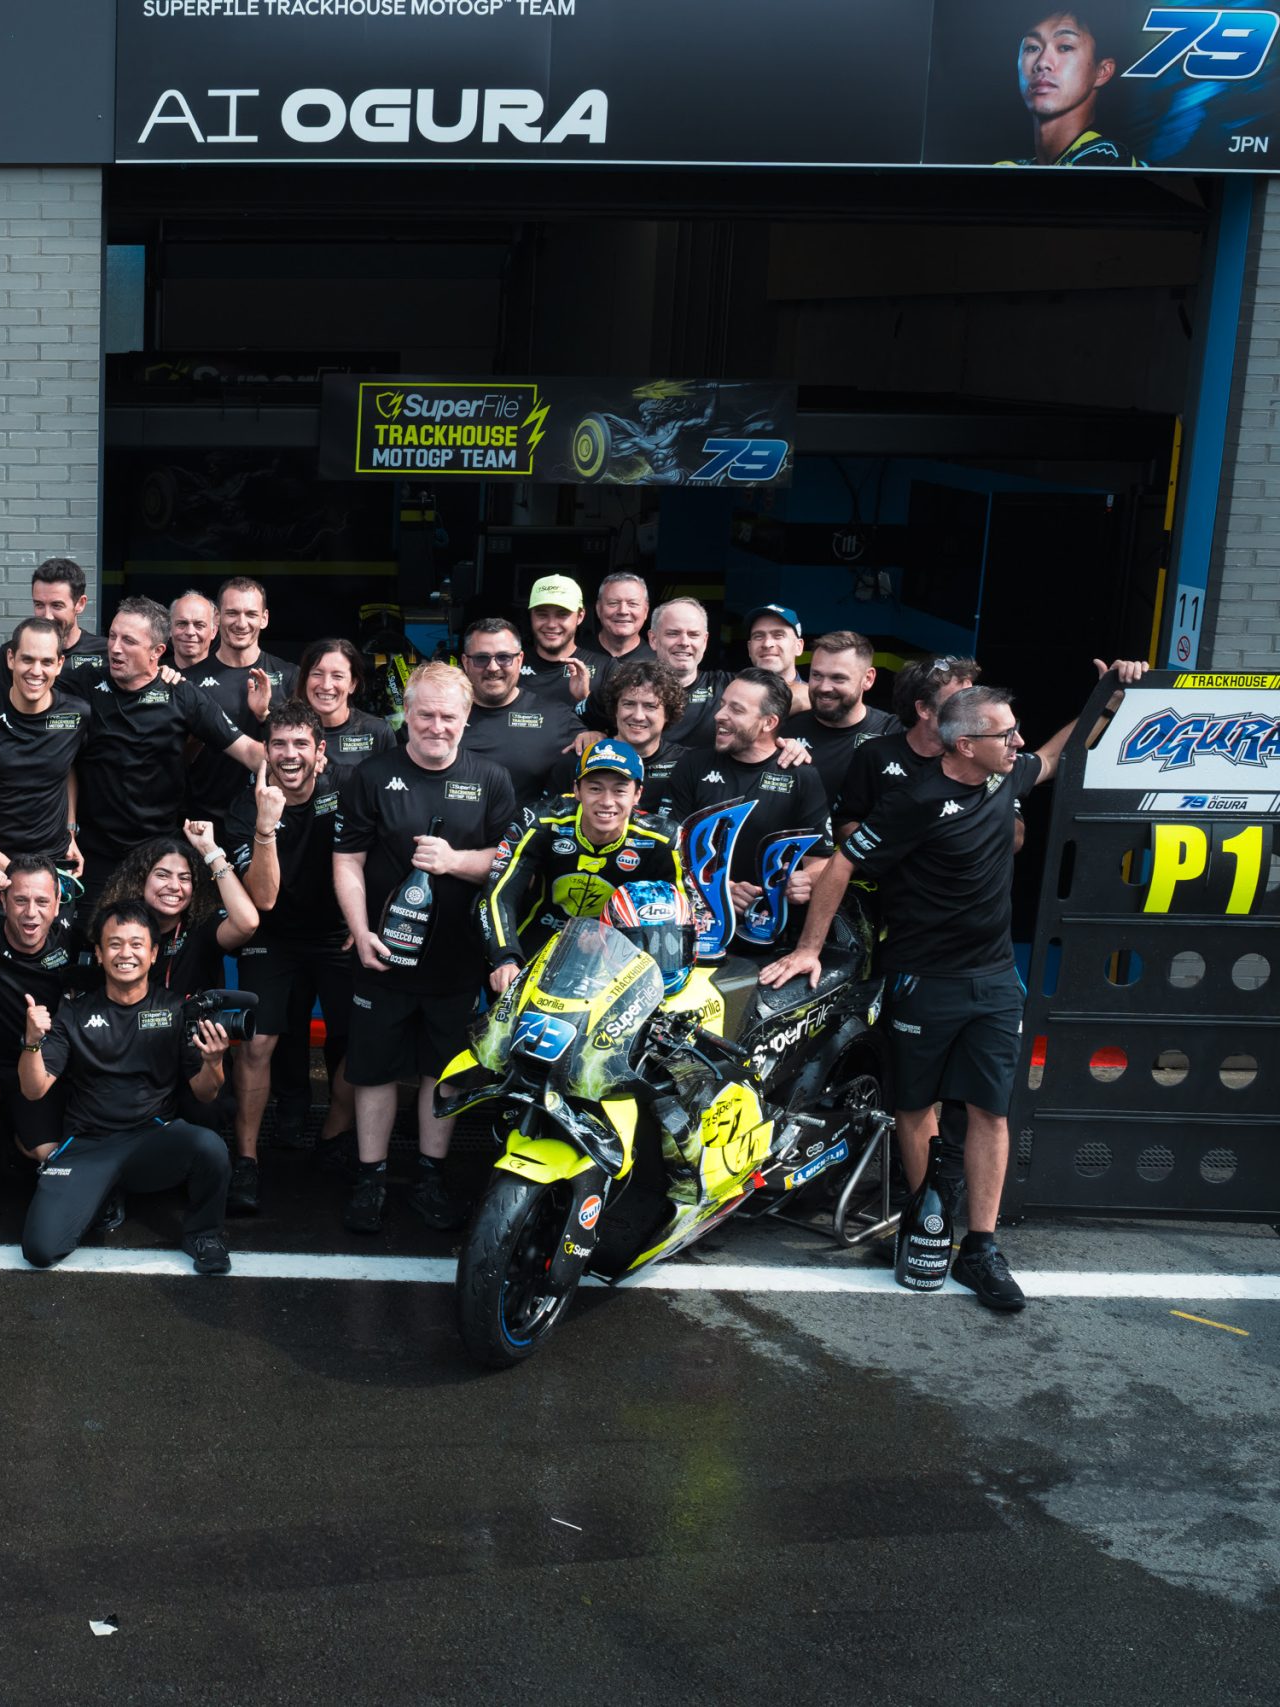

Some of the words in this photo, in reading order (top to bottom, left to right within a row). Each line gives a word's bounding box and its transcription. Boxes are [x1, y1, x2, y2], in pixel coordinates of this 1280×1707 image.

[143, 0, 259, 17] SUPERFILE
[264, 0, 406, 17] TRACKHOUSE
[519, 0, 576, 17] TEAM
[1121, 8, 1280, 79] 79
[137, 88, 260, 144] AI
[280, 88, 609, 144] OGURA
[1228, 136, 1269, 153] JPN
[375, 424, 518, 447] TRACKHOUSE
[461, 448, 517, 468] TEAM
[688, 437, 789, 481] 79
[1179, 592, 1200, 631] 11
[1191, 675, 1268, 688] TRACKHOUSE
[1176, 795, 1210, 809] 79
[1207, 800, 1248, 810] OGURA
[618, 855, 639, 866] Gulf
[1143, 824, 1263, 915] P1
[389, 904, 417, 919] PROSECCO
[384, 928, 412, 941] PROSECCO
[610, 955, 652, 996] TRACKHOUSE
[537, 996, 565, 1011] aprilia
[605, 984, 656, 1039] SuperFile
[581, 1201, 601, 1222] Gulf
[910, 1235, 940, 1247] PROSECCO
[908, 1256, 948, 1269] WINNER
